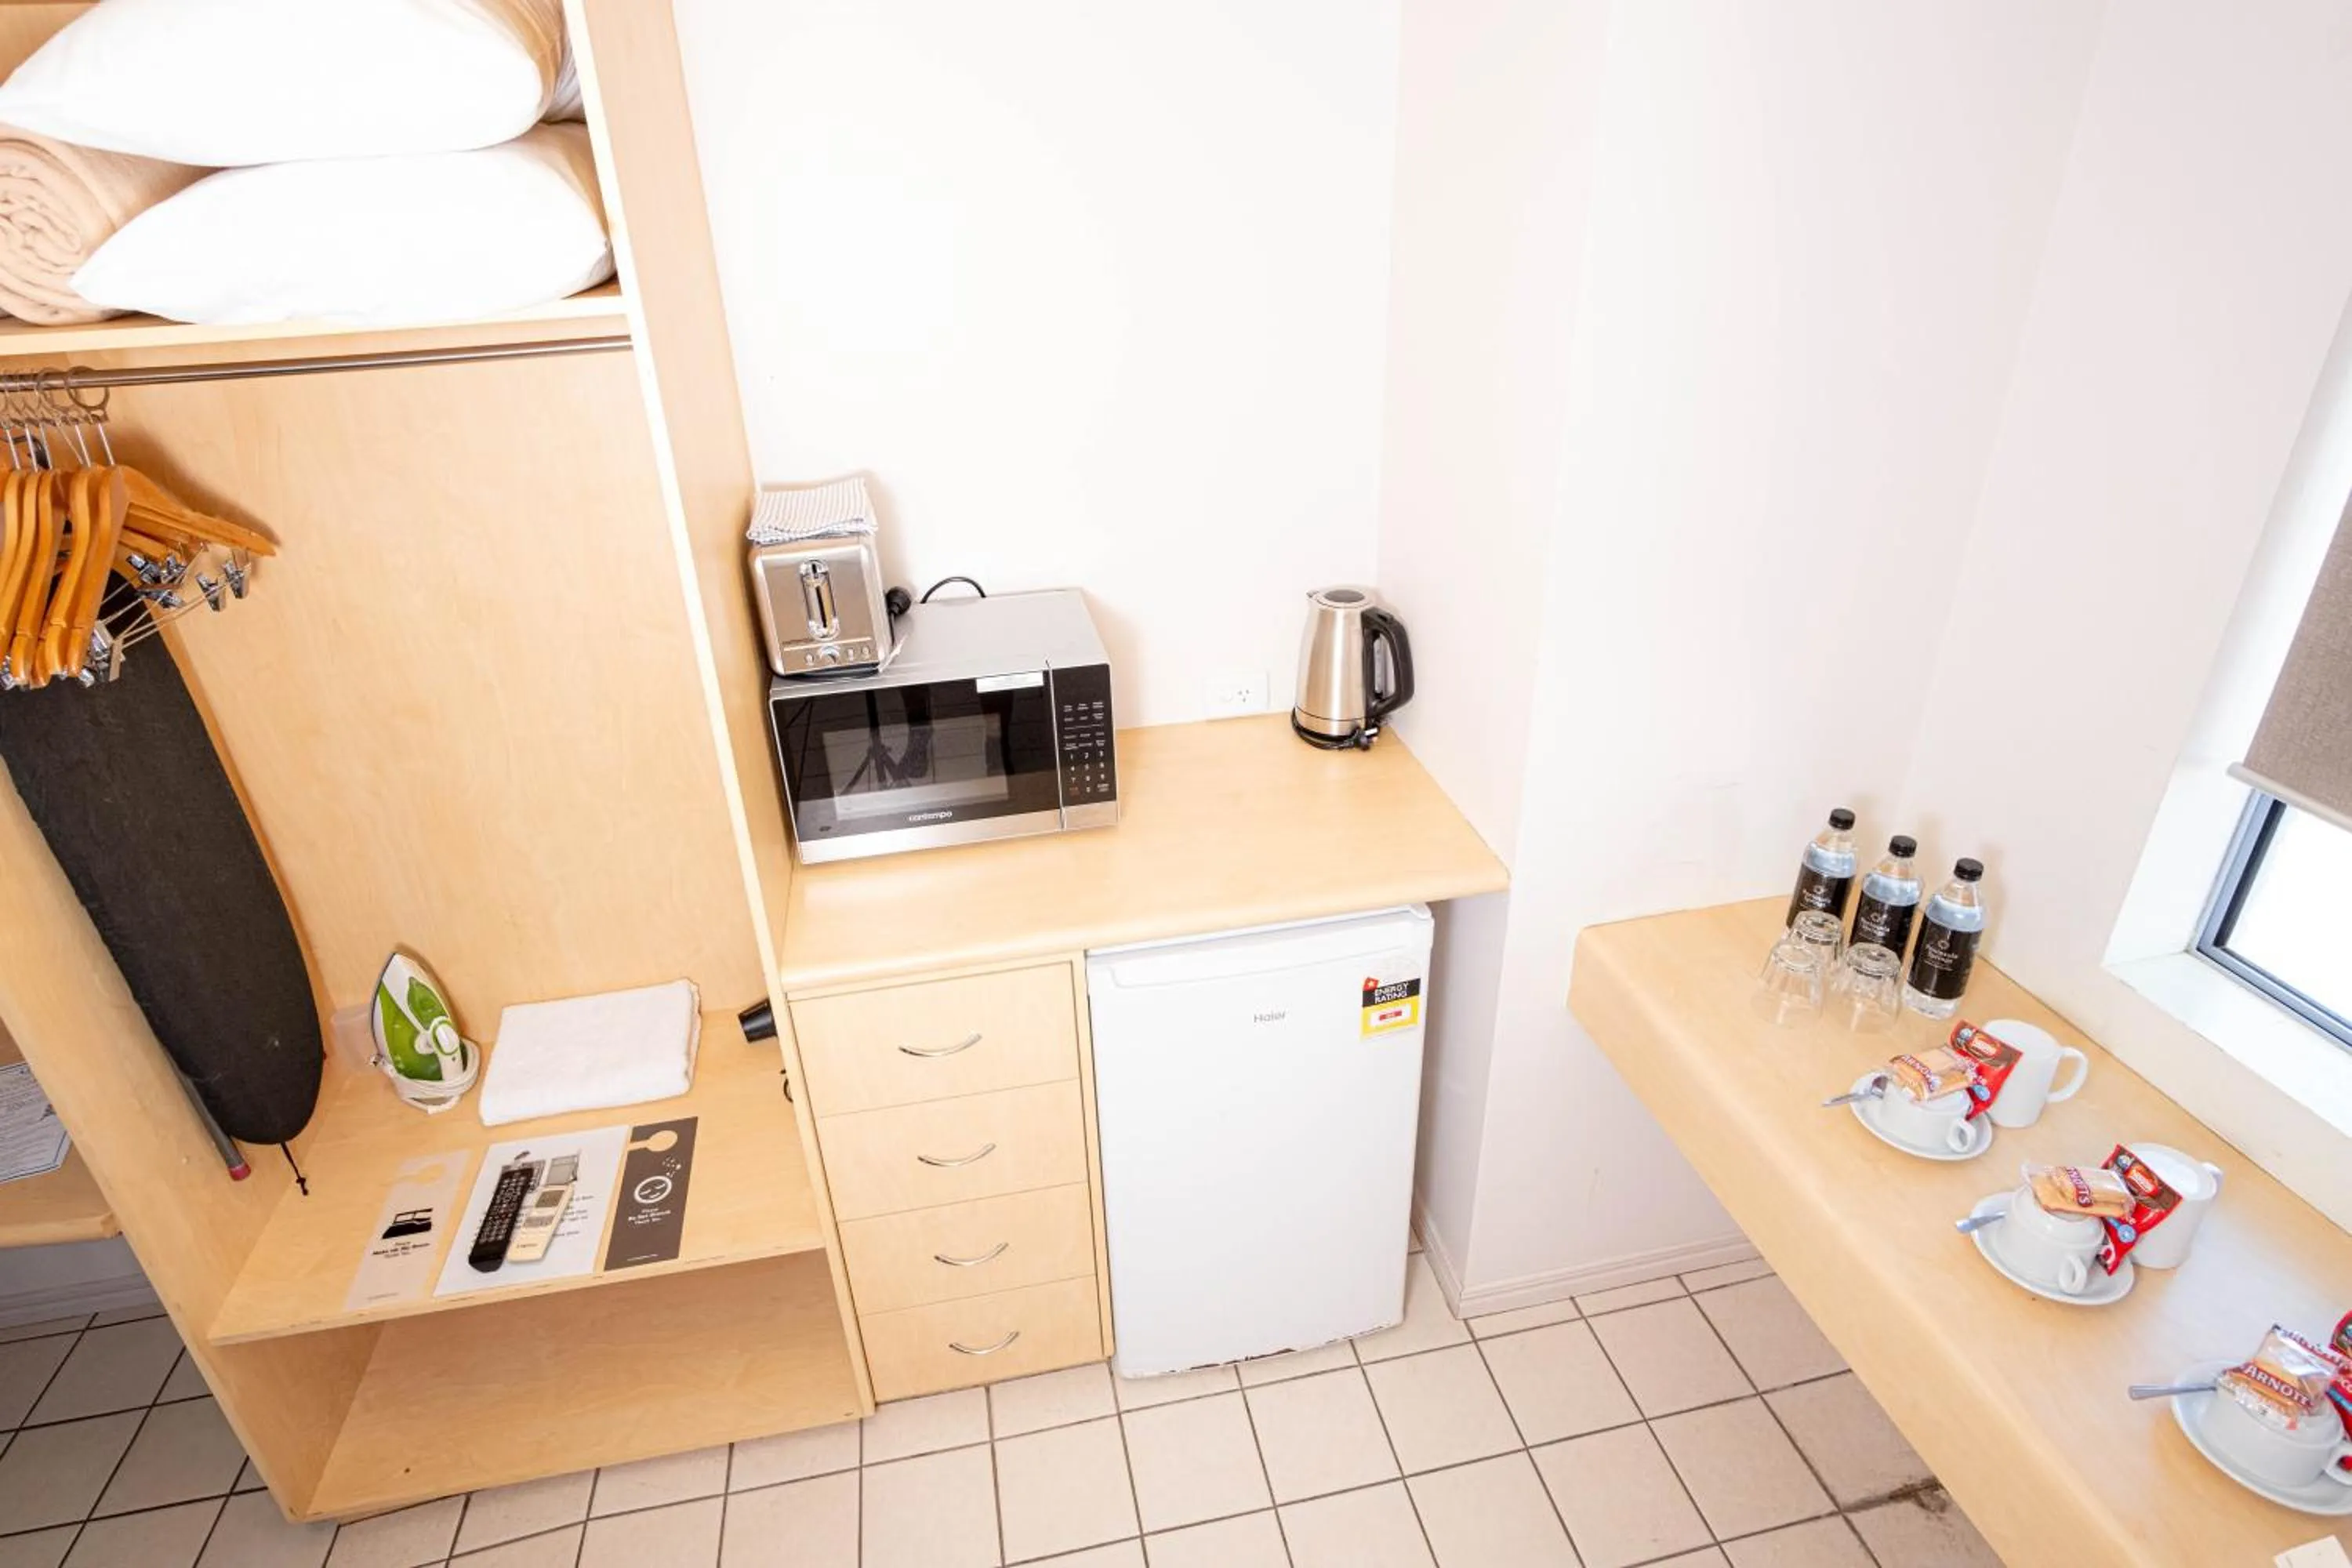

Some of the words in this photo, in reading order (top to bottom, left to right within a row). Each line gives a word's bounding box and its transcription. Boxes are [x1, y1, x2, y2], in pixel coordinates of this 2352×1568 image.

[909, 811, 953, 822] contempo
[1375, 982, 1409, 996] ENERGY
[1375, 991, 1408, 1004] RATING
[1254, 1010, 1286, 1023] Haier
[2245, 1365, 2311, 1407] ARNOTT
